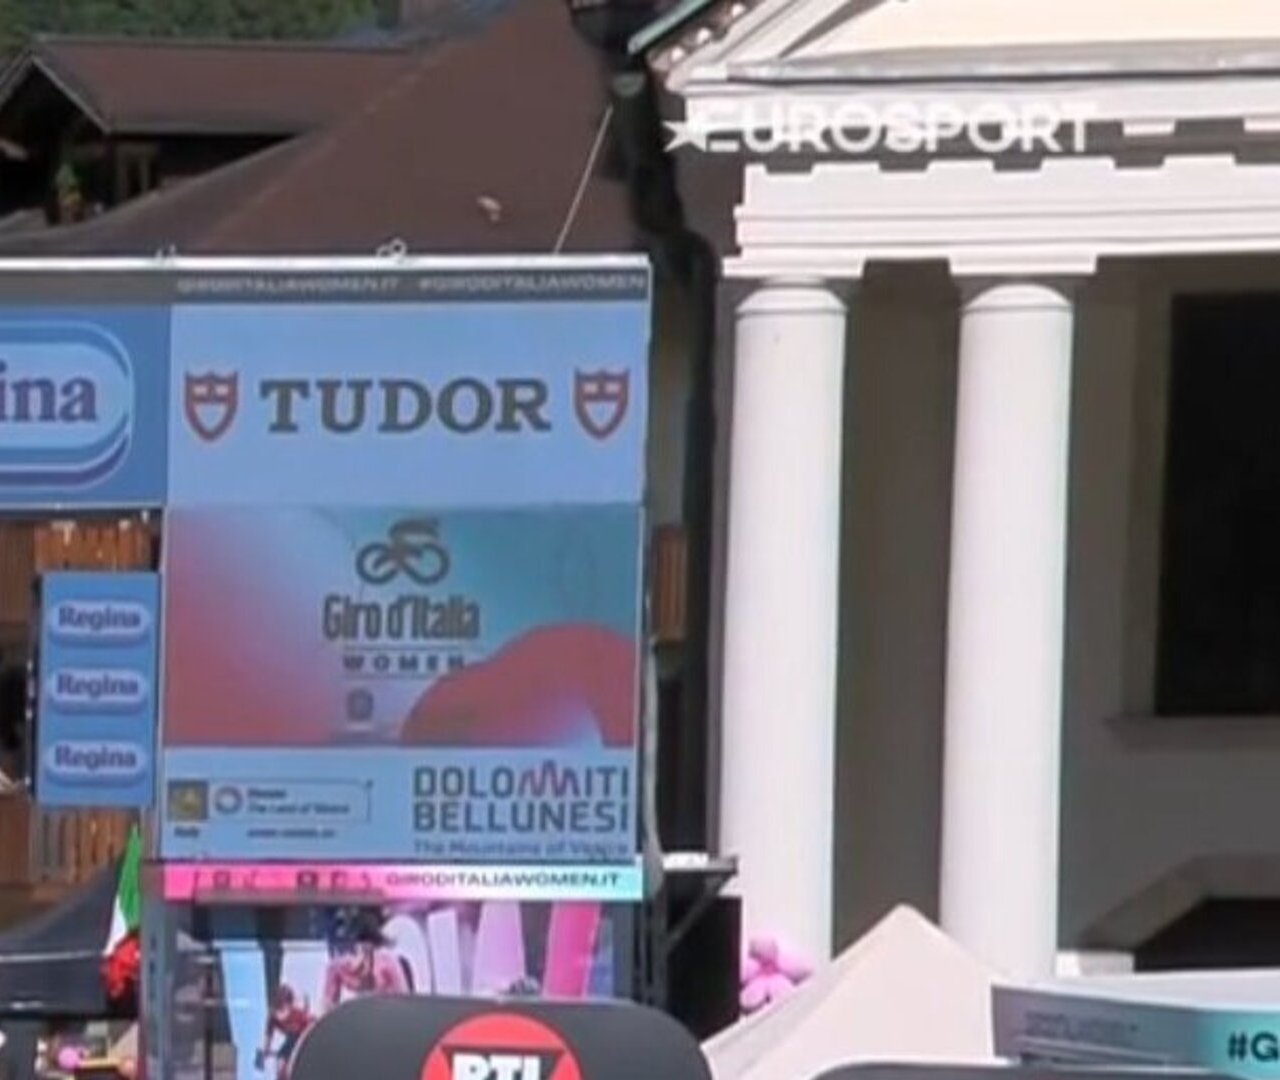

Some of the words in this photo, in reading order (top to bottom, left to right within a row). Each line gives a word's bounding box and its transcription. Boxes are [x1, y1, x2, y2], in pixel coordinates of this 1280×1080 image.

[259, 377, 552, 433] TUDOR
[58, 606, 141, 629] Regina
[323, 593, 382, 640] Giro
[387, 593, 481, 640] d'Italia
[343, 654, 464, 671] WOMEN
[56, 674, 139, 697] Regina
[54, 745, 137, 769] Regina
[413, 801, 629, 832] BELLUNESI
